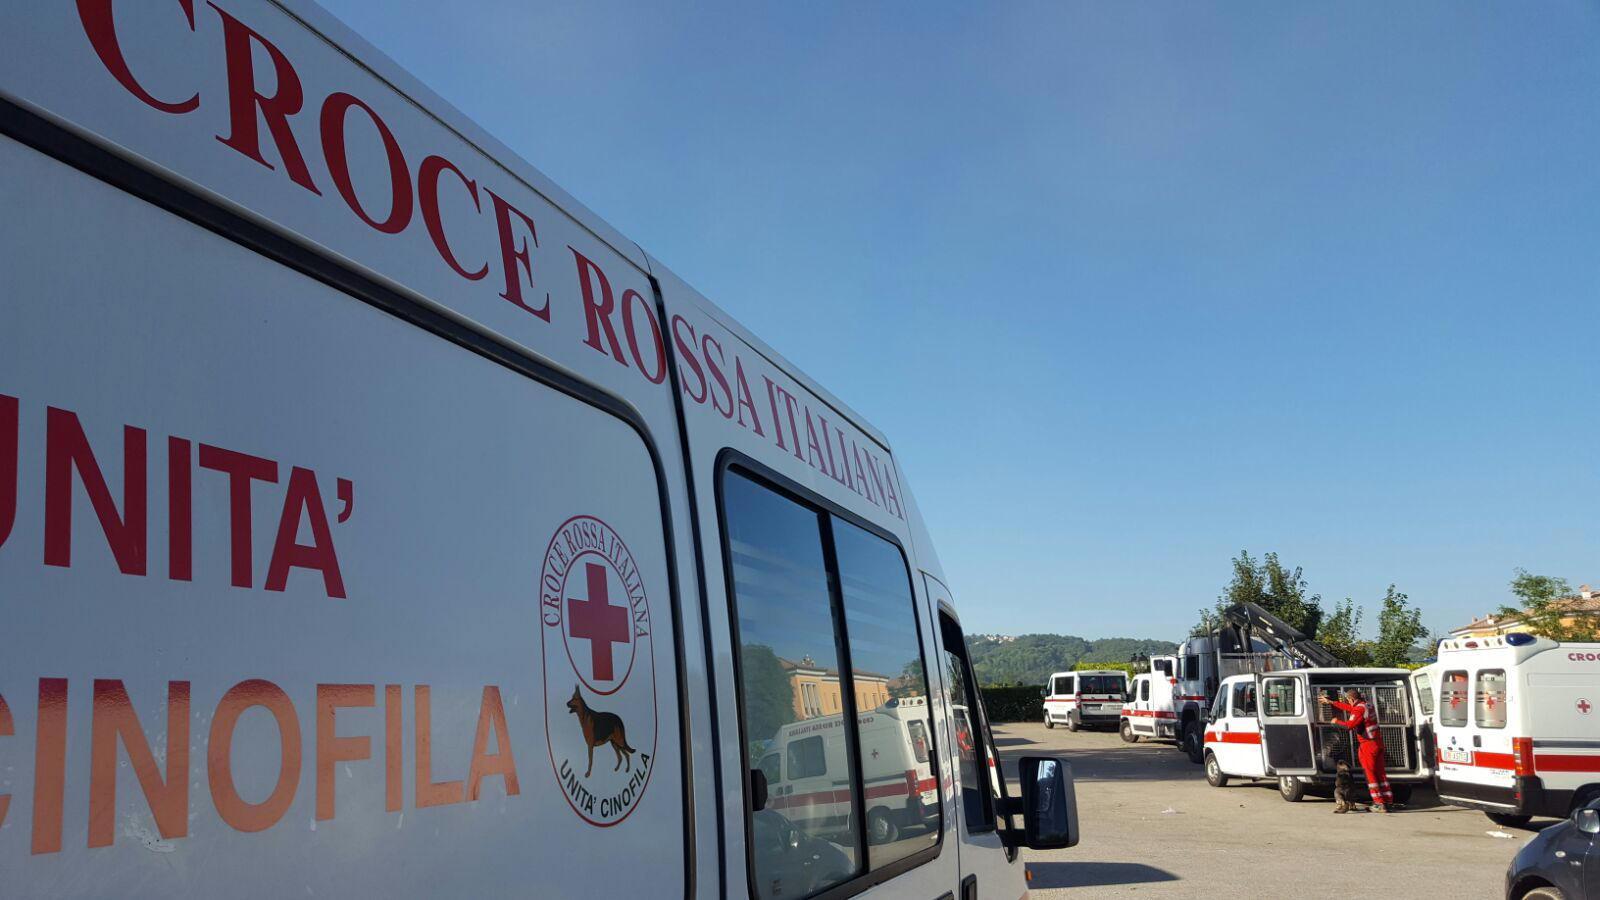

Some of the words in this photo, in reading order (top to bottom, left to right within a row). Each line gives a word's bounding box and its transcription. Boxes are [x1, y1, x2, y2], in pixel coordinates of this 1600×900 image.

[76, 0, 550, 323] CROCE
[567, 245, 765, 438] ROSSA
[761, 374, 904, 521] ITALIANA
[0, 394, 353, 599] NITA'
[543, 541, 569, 627] CROCE
[562, 521, 606, 556] ROSSA
[609, 535, 649, 637] ITALIANA
[0, 678, 520, 856] INOFILA
[560, 759, 597, 814] UNITA'
[601, 753, 650, 818] CINOFILA
